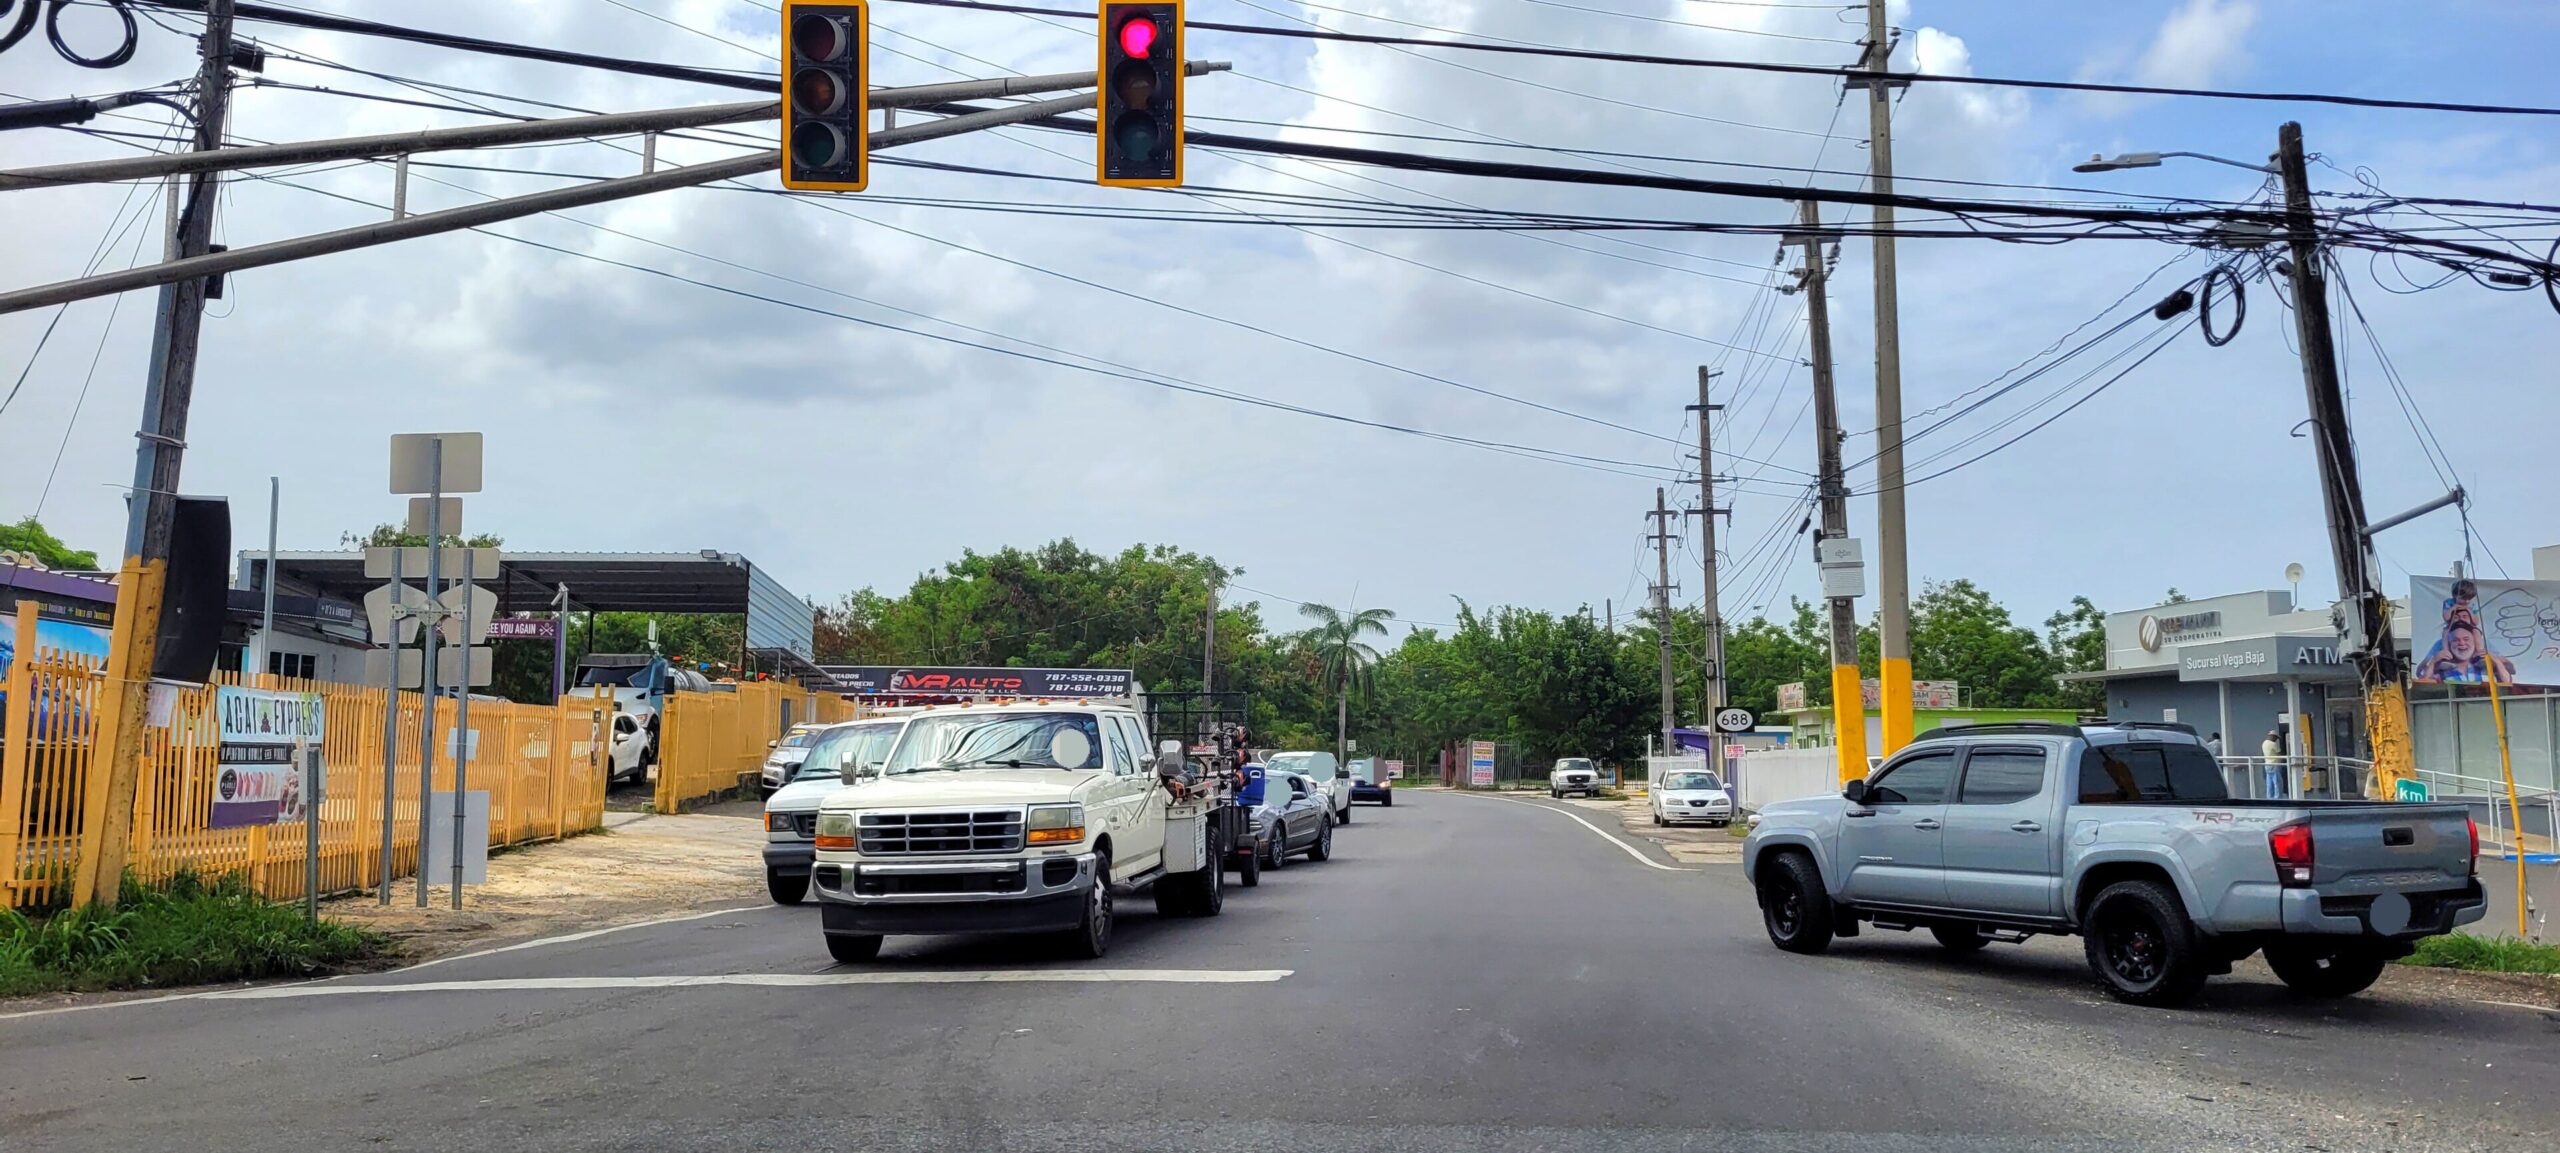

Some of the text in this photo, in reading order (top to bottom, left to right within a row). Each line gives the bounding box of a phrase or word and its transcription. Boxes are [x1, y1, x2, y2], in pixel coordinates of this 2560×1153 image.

[500, 623, 514, 634] YOU
[515, 623, 536, 635] AGAIN
[2174, 631, 2222, 643] COOPERATIVA
[2186, 651, 2265, 670] Sucursal Vega Baja
[2295, 646, 2344, 664] ATM
[950, 678, 1022, 688] AUTO
[1045, 674, 1125, 682] 787-552-0330
[1048, 684, 1124, 692] 787-631-7818
[225, 695, 257, 734] ACAI
[274, 699, 321, 737] EXPRESS
[1721, 713, 1749, 726] 688
[2400, 786, 2424, 802] km
[2192, 811, 2234, 824] TRD
